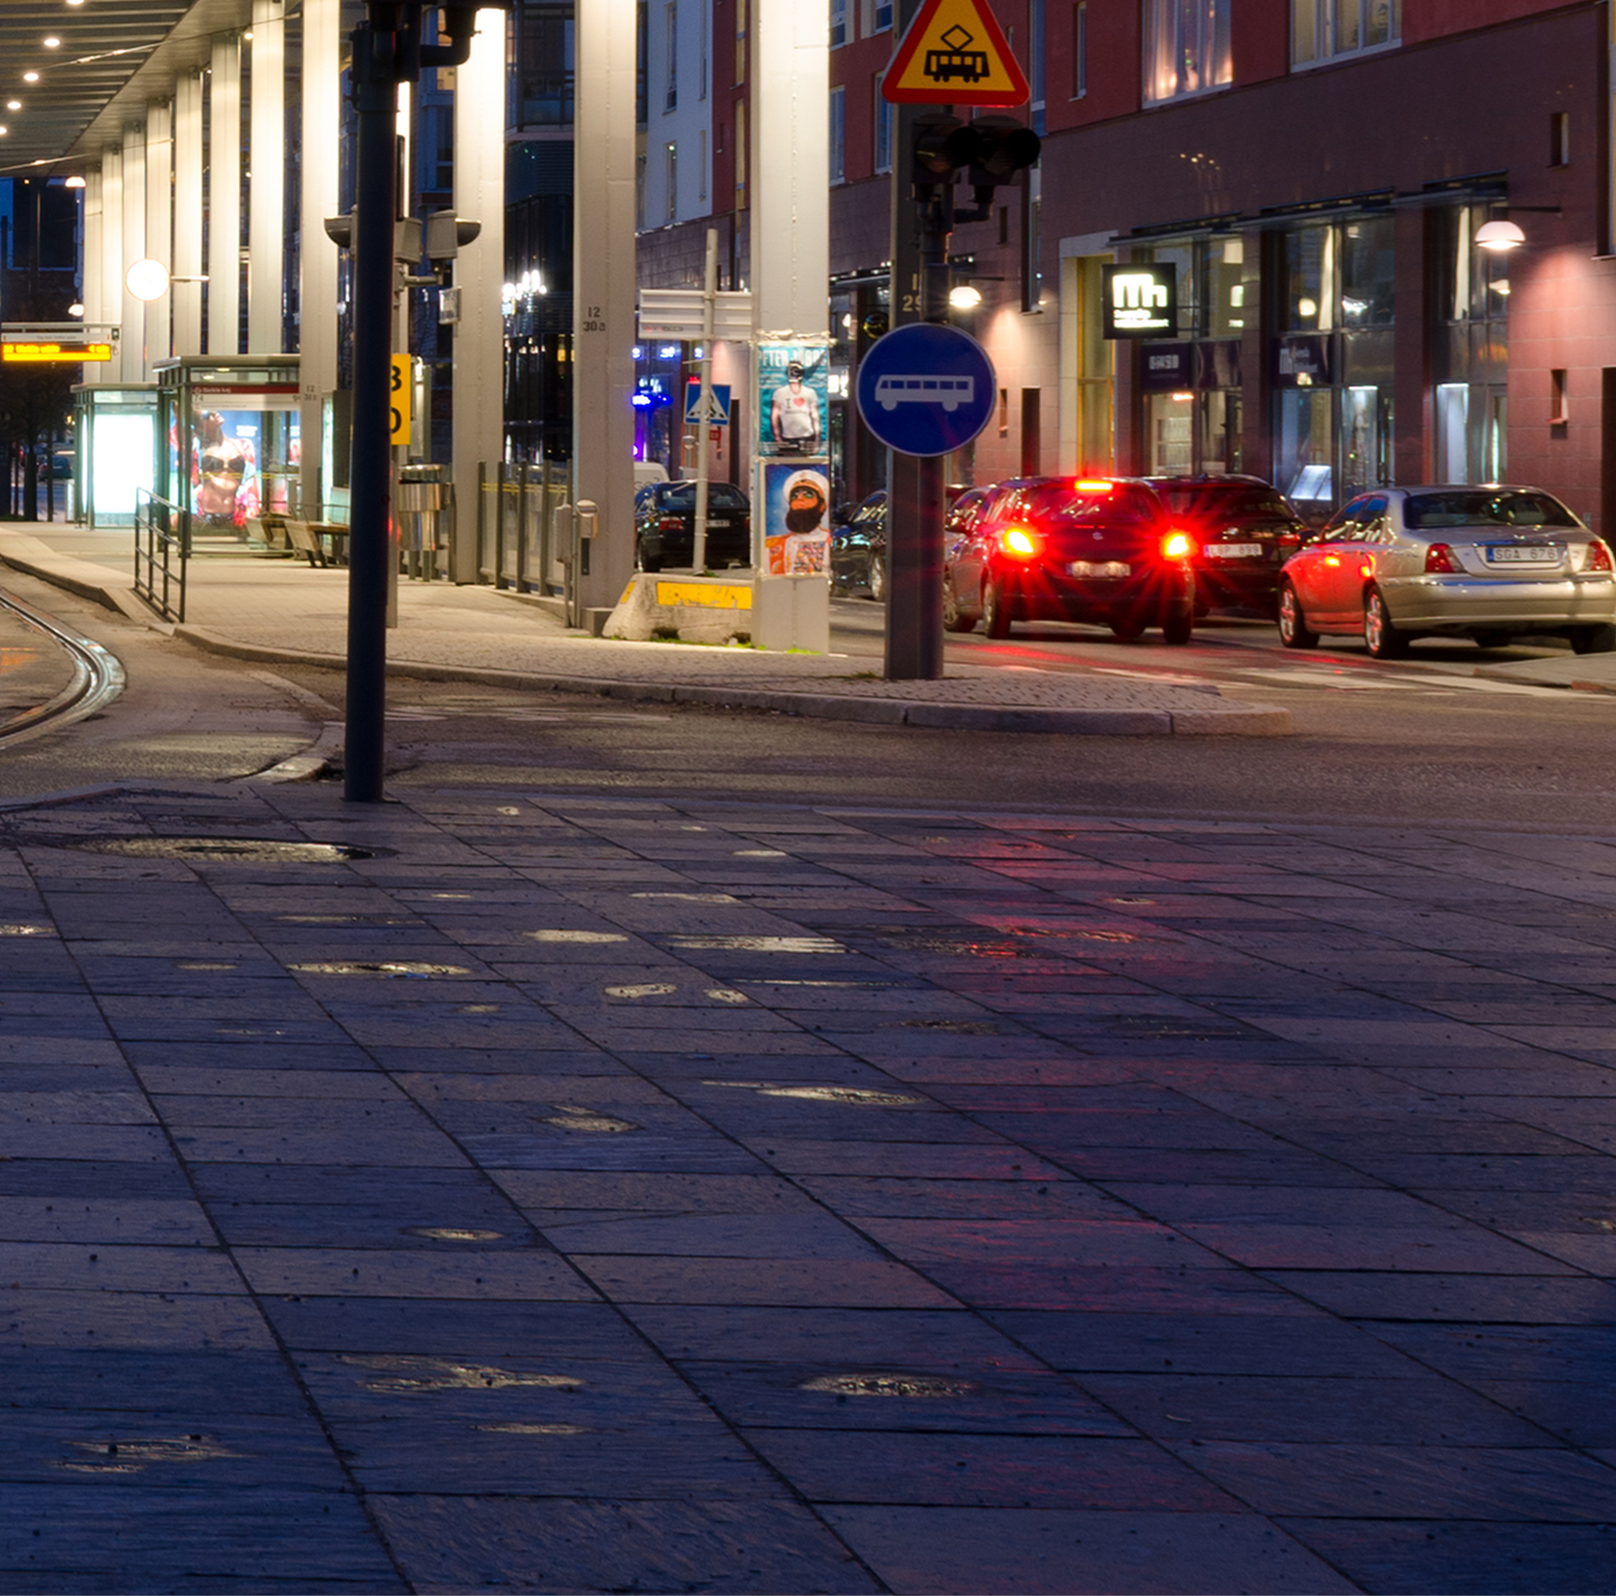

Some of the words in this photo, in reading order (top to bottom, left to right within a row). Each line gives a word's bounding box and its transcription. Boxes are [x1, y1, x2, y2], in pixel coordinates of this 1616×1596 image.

[588, 306, 601, 318] 12
[1495, 548, 1521, 560] SGA
[1530, 548, 1556, 560] 676
